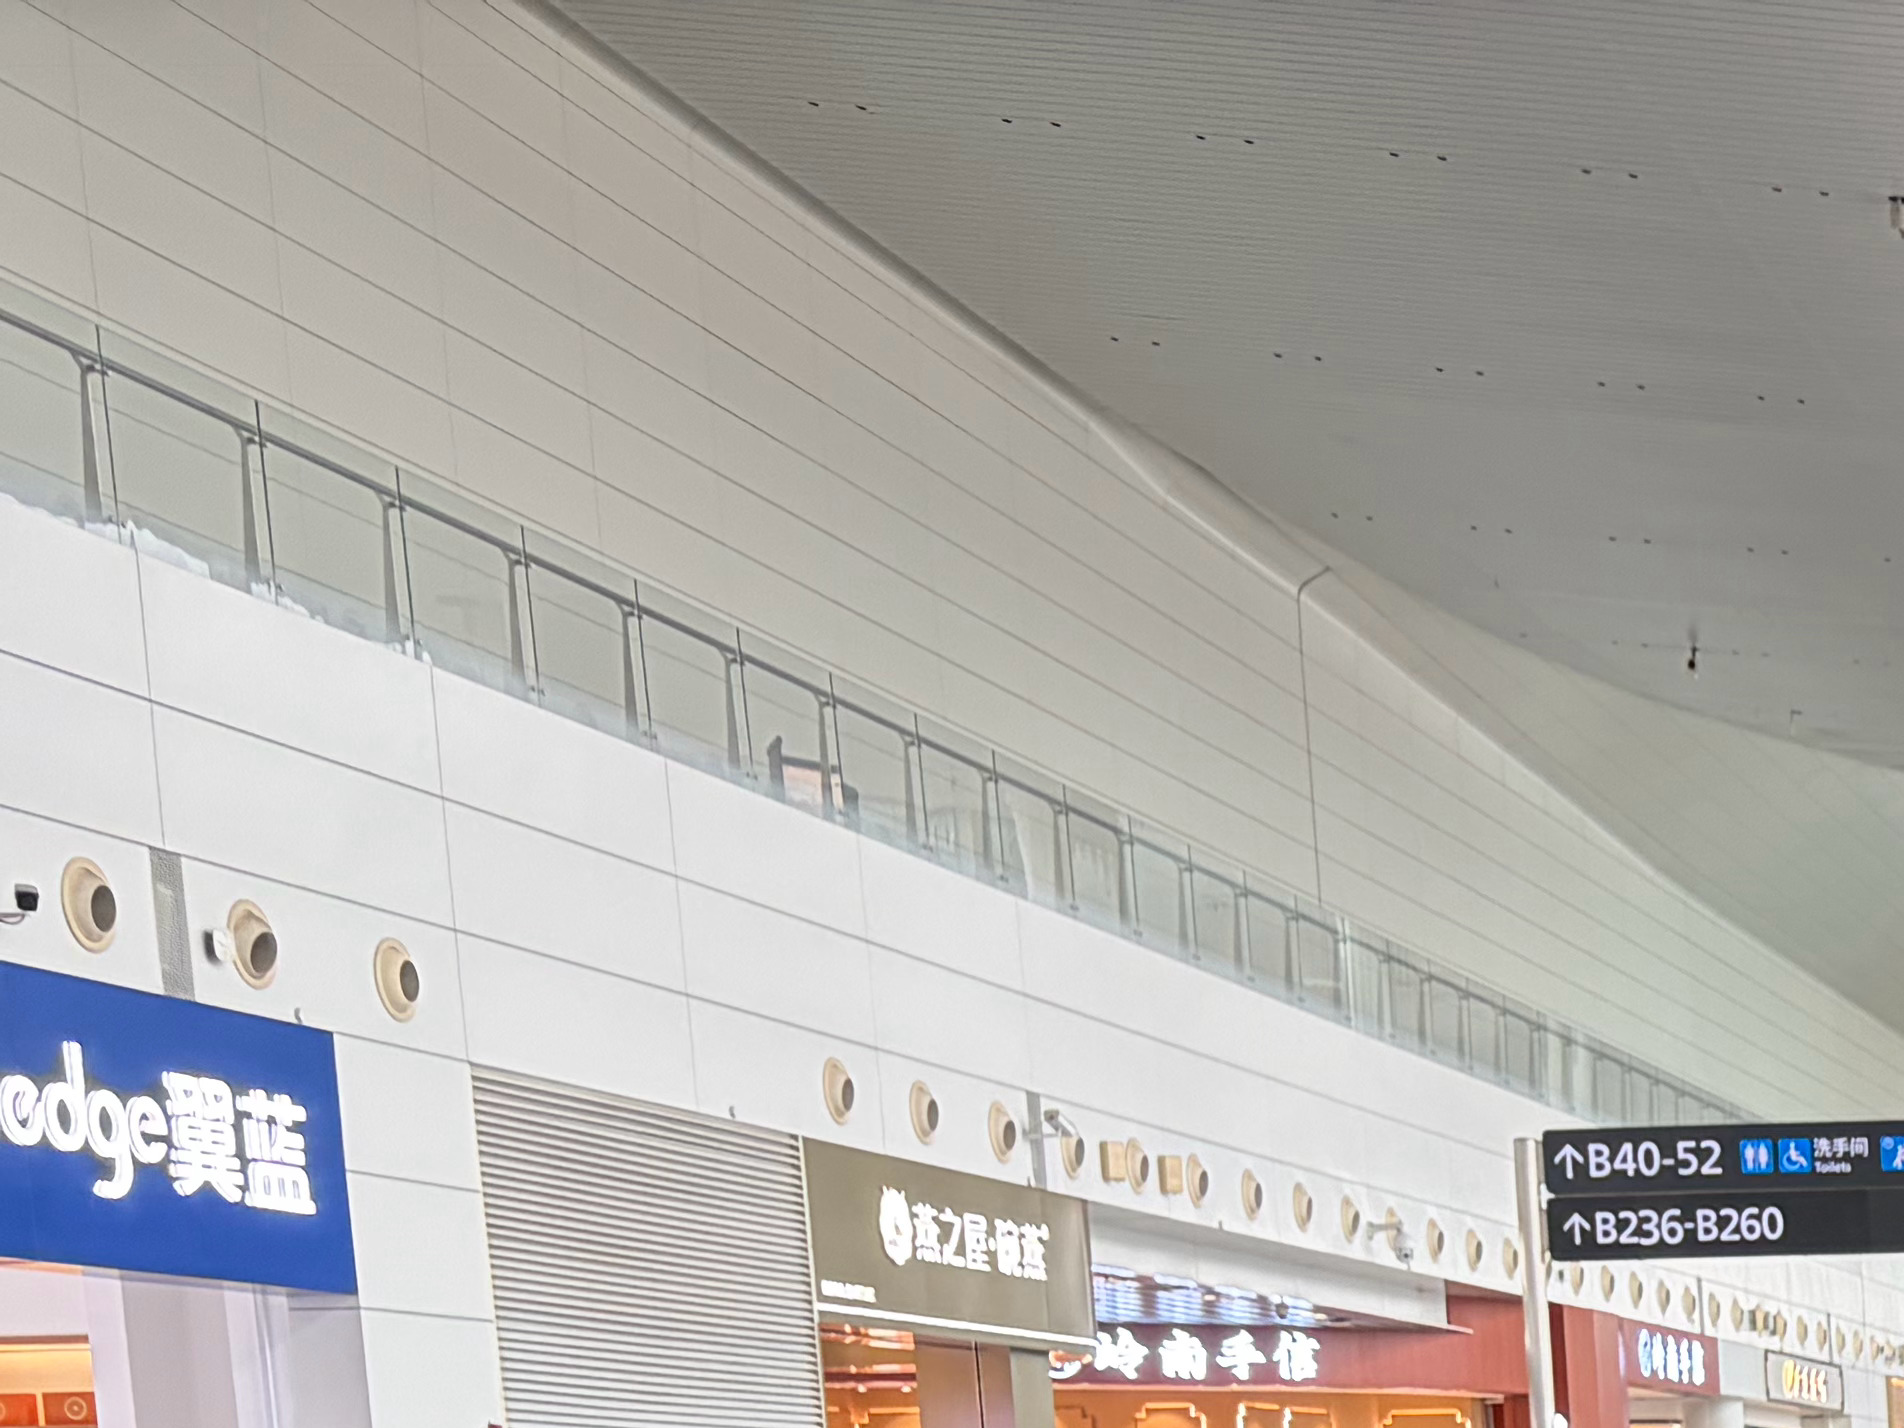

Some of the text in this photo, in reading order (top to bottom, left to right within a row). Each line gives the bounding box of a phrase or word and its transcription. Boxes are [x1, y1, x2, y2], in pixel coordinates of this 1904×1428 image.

[161, 1071, 317, 1216] 翼蓝
[1587, 1140, 1724, 1178] B40-52
[1813, 1136, 1869, 1158] 洗手间
[1595, 1206, 1785, 1245] B236-B260
[1095, 1327, 1322, 1382] 岭南手信
